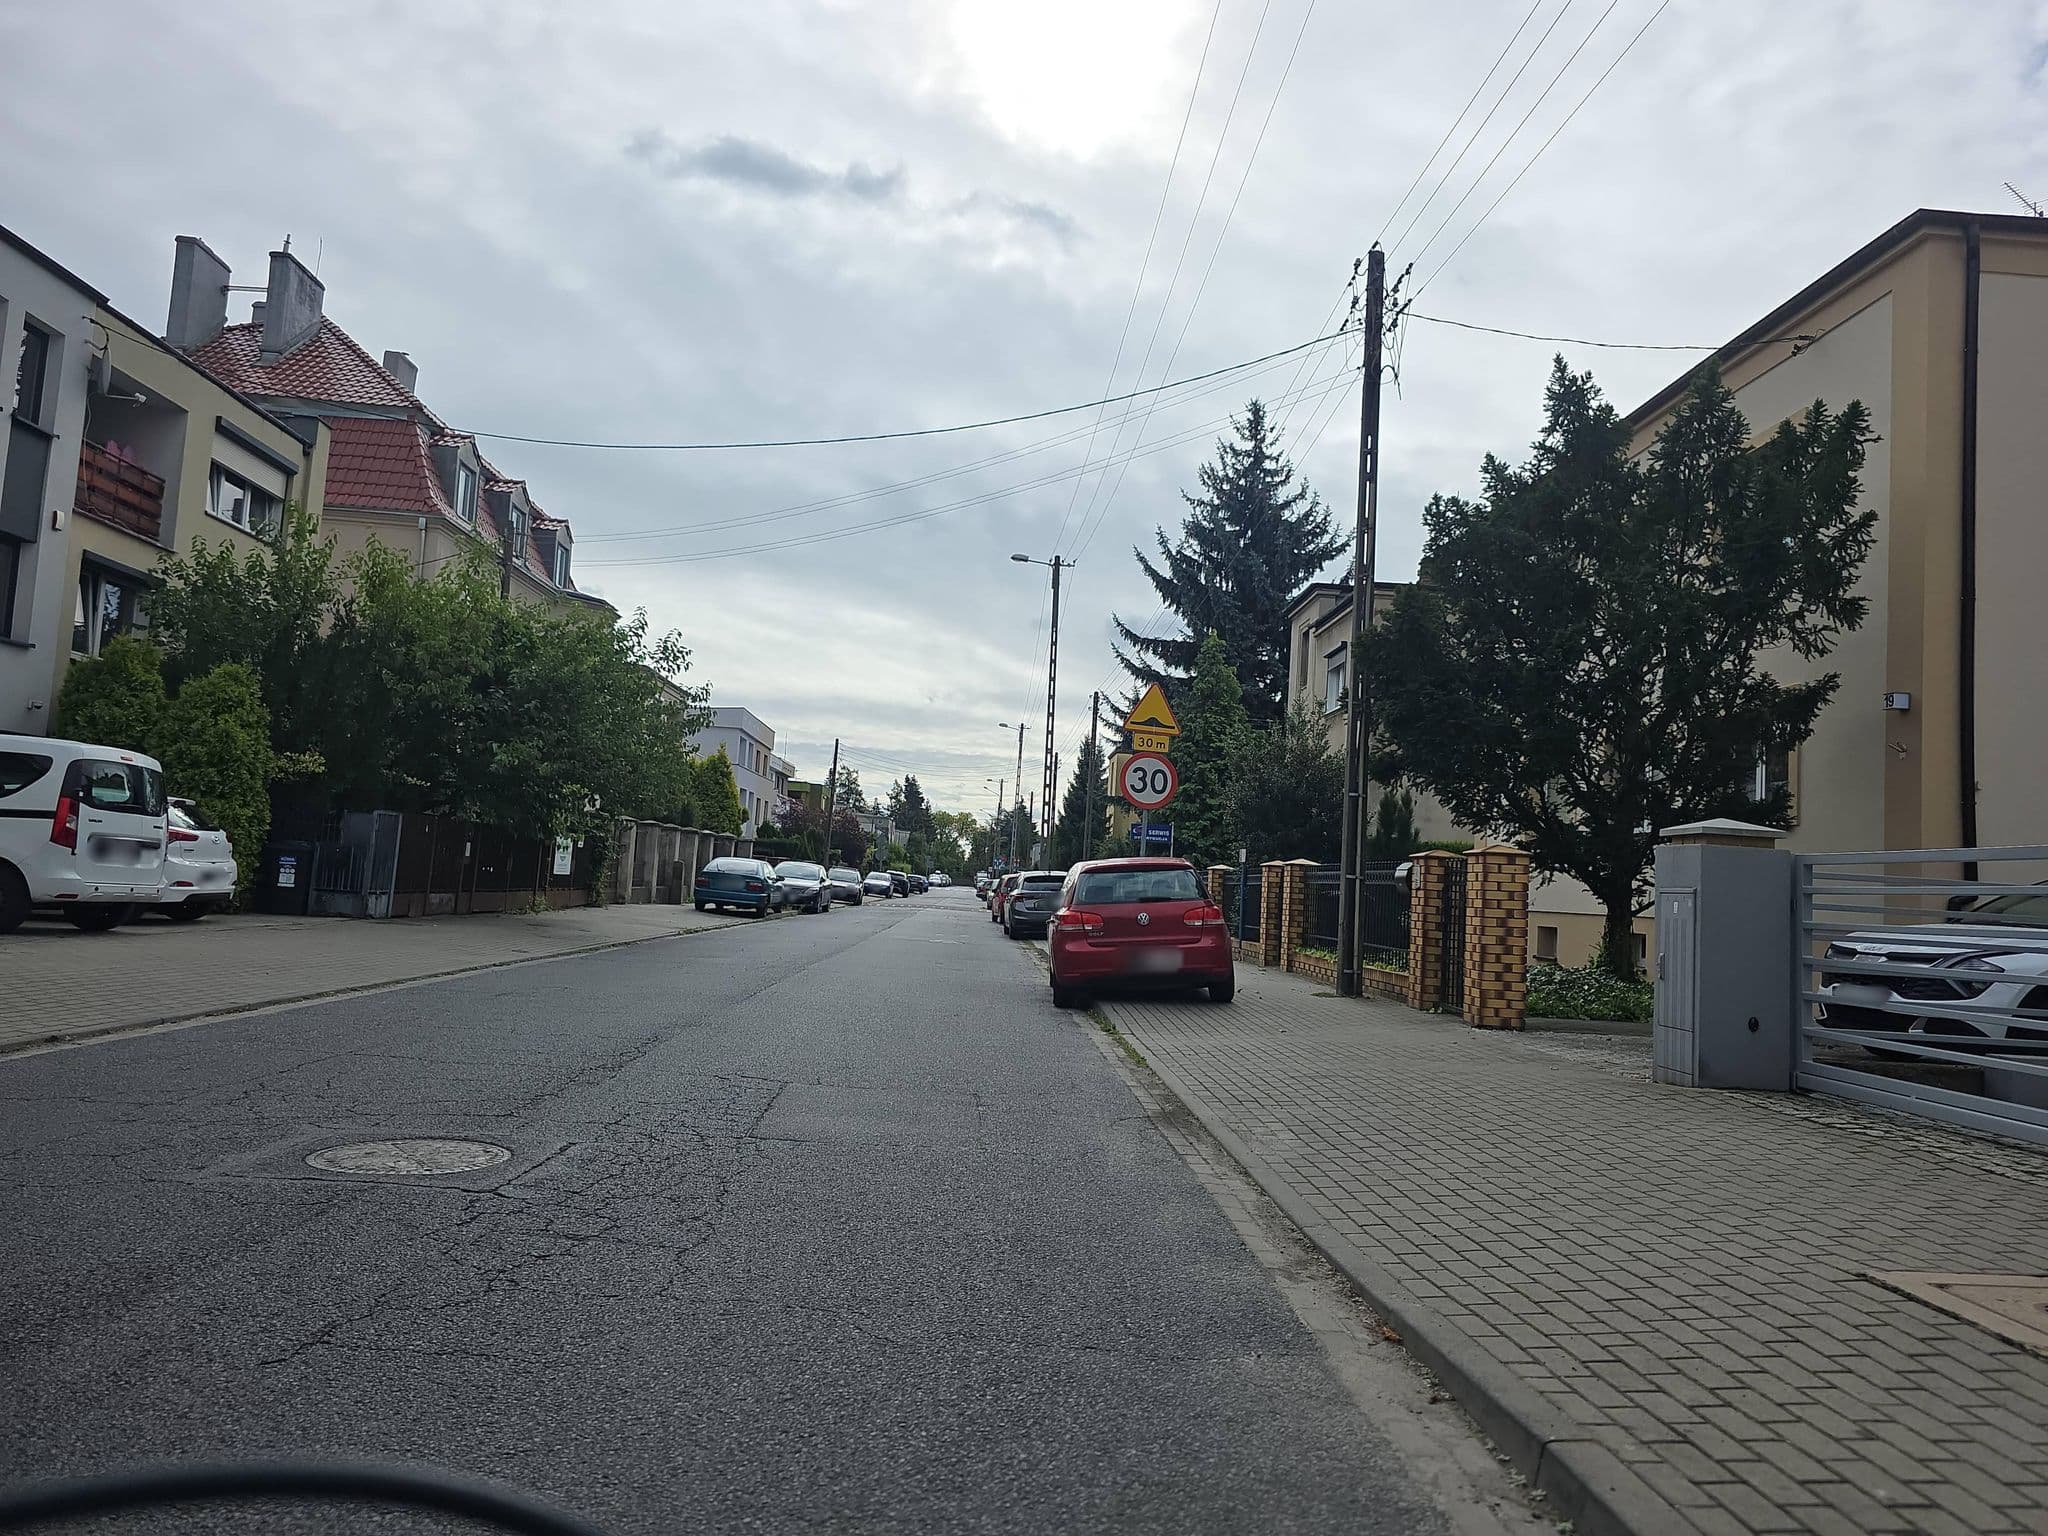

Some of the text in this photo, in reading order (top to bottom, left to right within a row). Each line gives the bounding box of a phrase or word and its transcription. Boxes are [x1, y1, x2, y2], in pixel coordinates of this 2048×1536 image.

[1883, 695, 1894, 708] 19
[1138, 737, 1166, 749] 30 m
[1130, 767, 1168, 794] 30
